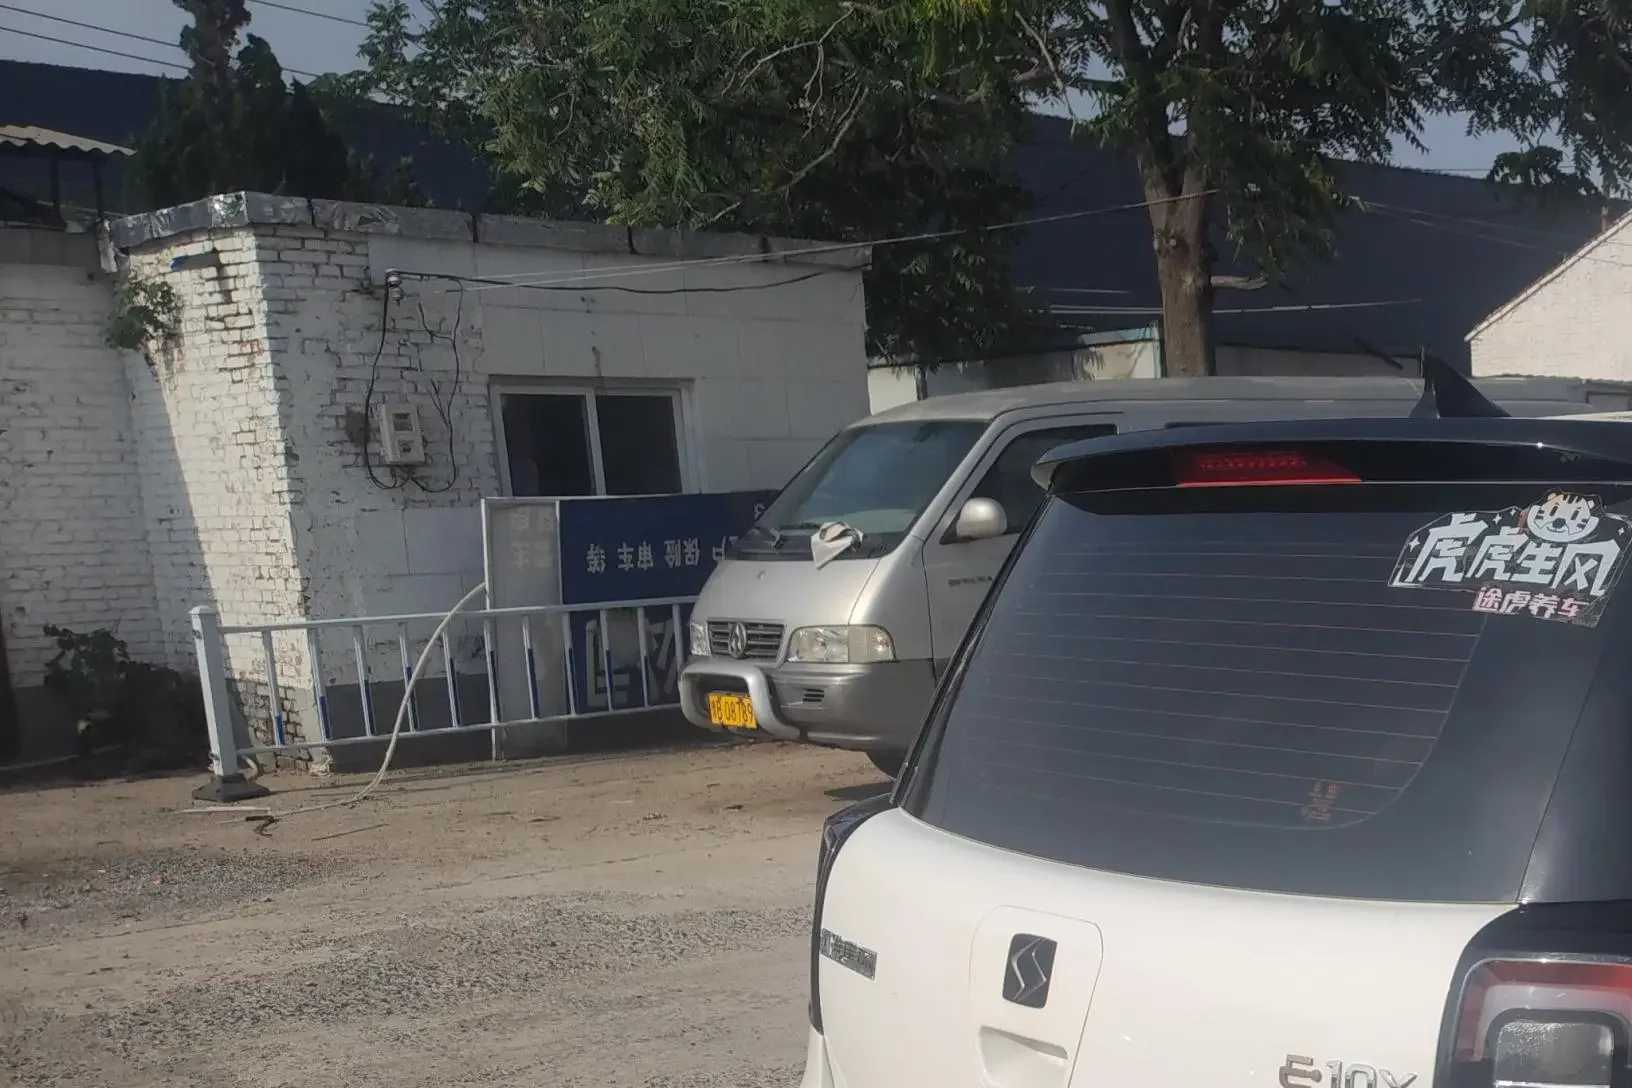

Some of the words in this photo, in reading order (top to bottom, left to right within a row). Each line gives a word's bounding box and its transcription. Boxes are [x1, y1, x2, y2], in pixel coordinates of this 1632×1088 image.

[617, 541, 654, 571] 审车
[663, 538, 700, 568] 保险
[1405, 512, 1621, 597] 虎虎生风
[1472, 585, 1588, 619] 途虎养车
